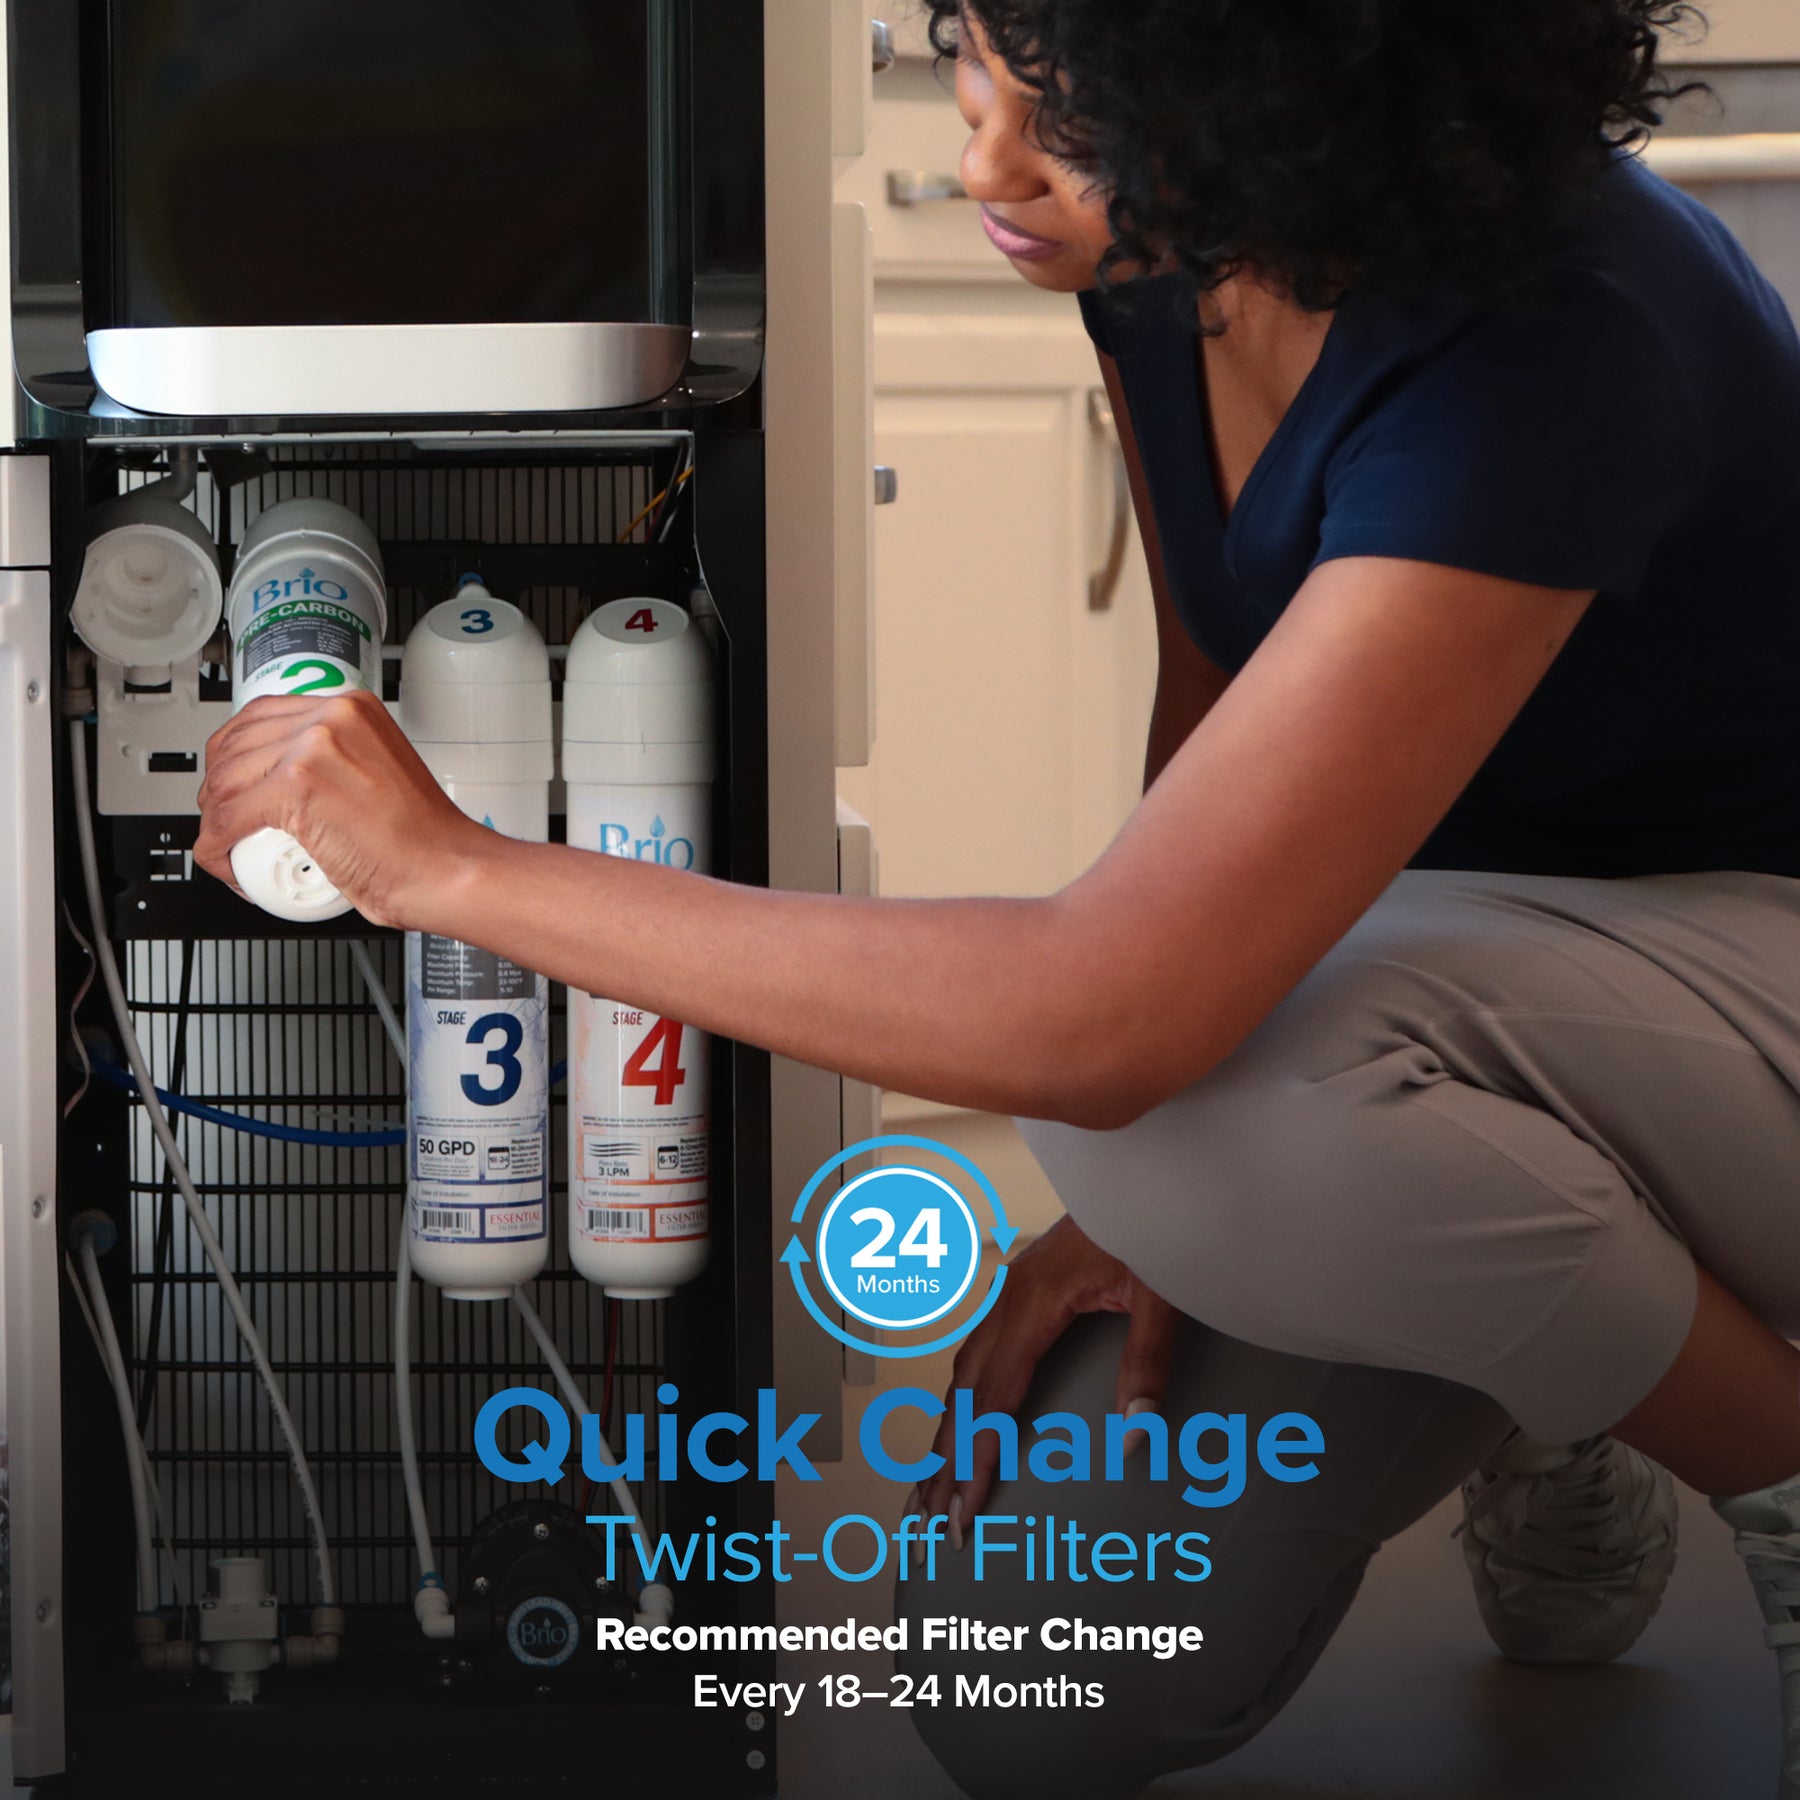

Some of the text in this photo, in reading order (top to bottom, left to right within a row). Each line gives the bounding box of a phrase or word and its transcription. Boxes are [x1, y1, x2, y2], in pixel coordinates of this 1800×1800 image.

[252, 567, 348, 615] Brio
[460, 609, 494, 634] 3
[625, 608, 659, 633] 4
[437, 1010, 466, 1025] STAGE
[612, 1011, 643, 1025] STAGE
[459, 1012, 524, 1107] 3
[621, 1016, 686, 1106] 4
[419, 1138, 476, 1156] 50 GPD
[659, 1154, 678, 1165] 6-12
[598, 1167, 630, 1177] 3 LPM
[490, 1210, 540, 1225] ESSENTIAL
[659, 1209, 706, 1225] ESSENTIA
[520, 1616, 568, 1647] Brio
